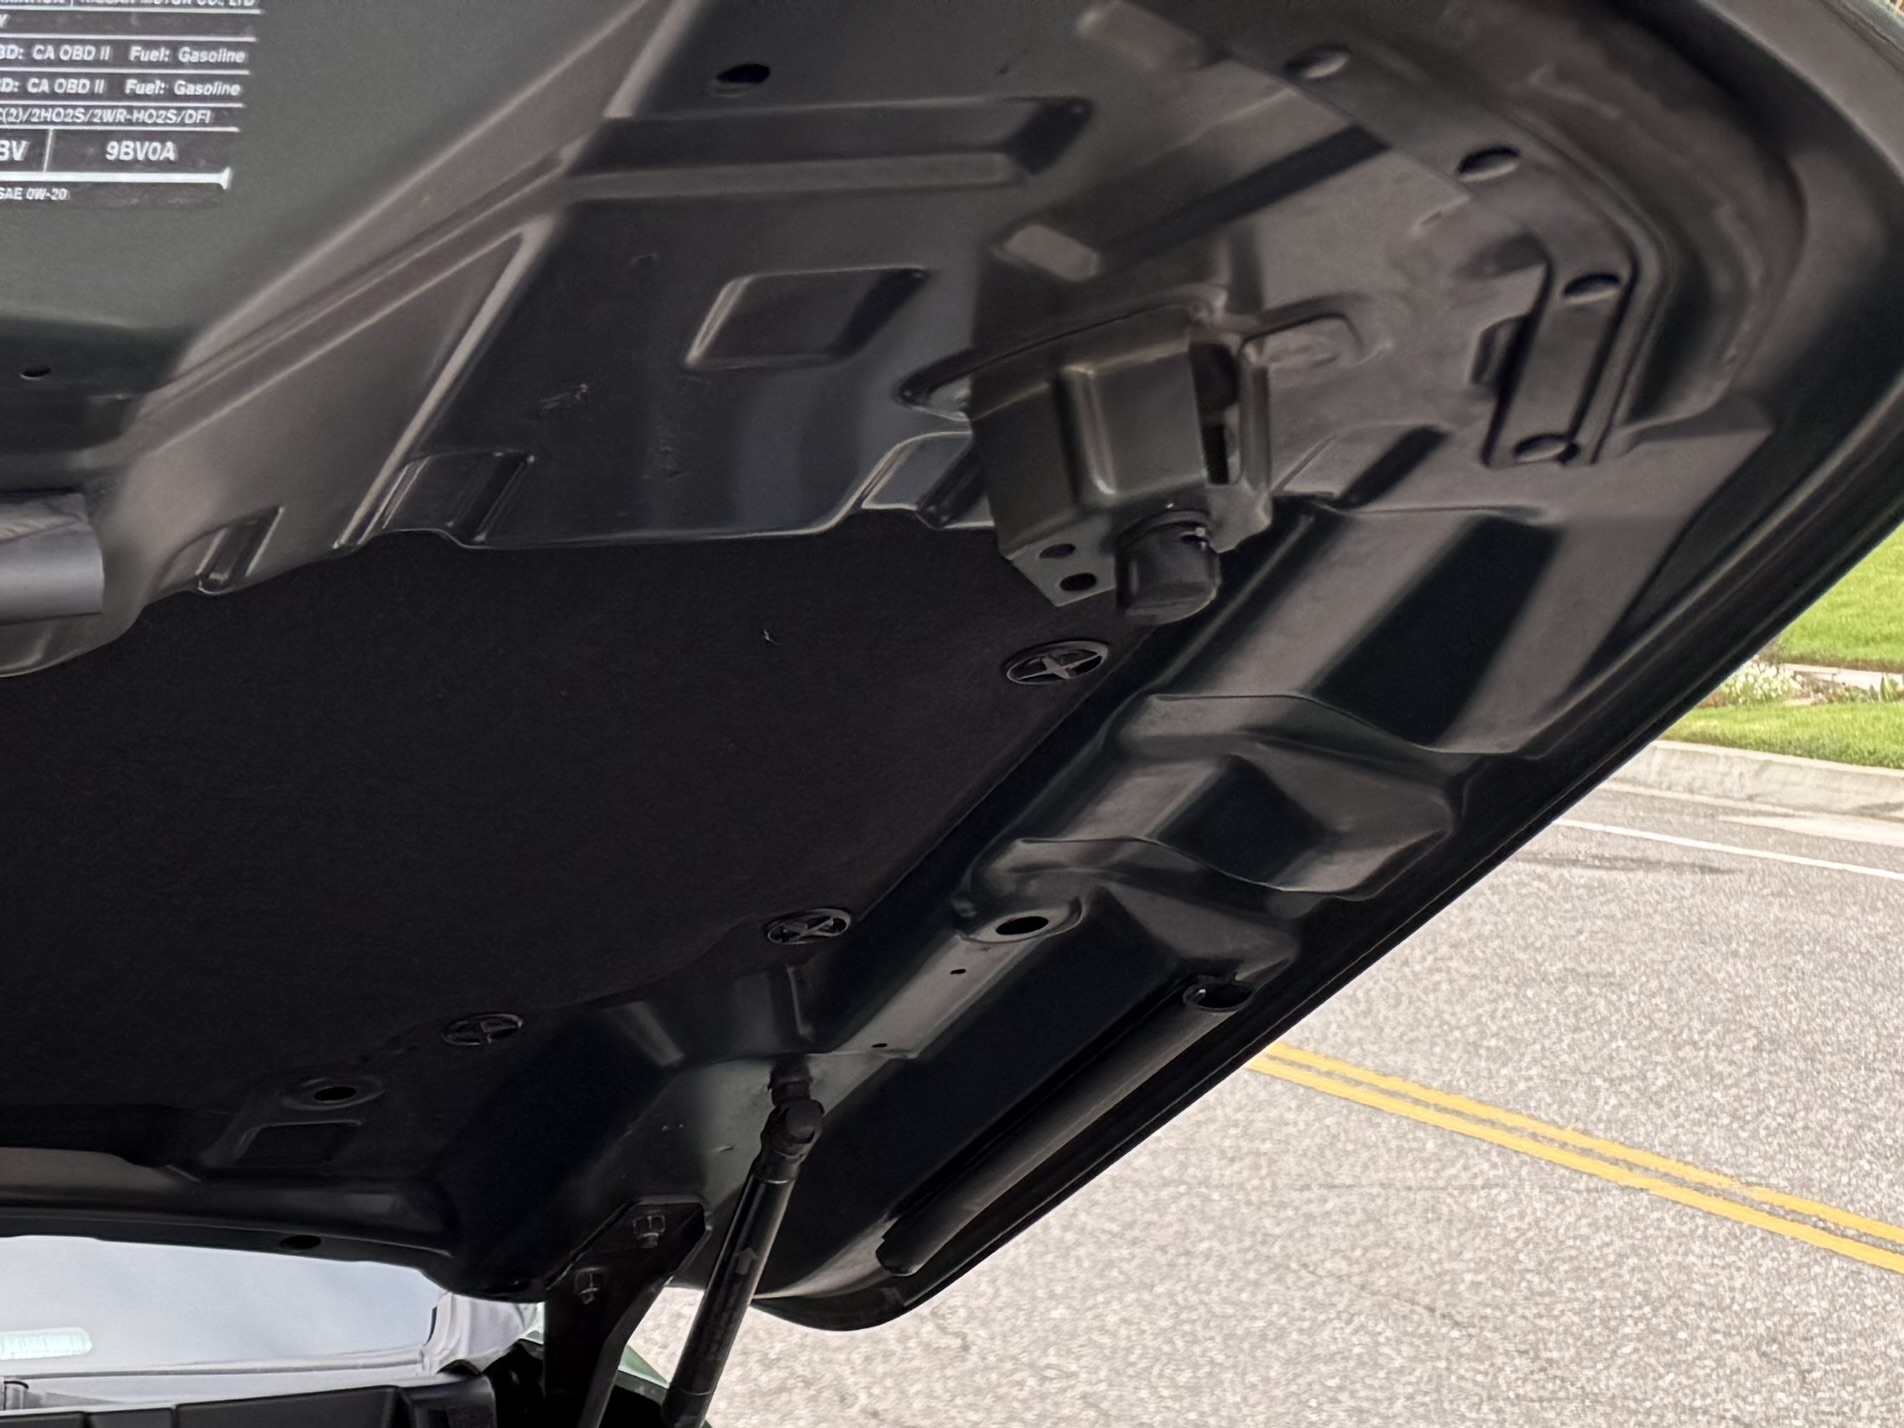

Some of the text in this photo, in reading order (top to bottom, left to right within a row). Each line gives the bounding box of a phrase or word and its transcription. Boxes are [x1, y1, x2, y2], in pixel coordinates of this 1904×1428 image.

[32, 45, 55, 60] CA
[59, 45, 96, 60] OBD
[129, 46, 246, 63] Fuel: Gasoline
[27, 78, 49, 93] CA
[54, 78, 90, 94] OBD
[125, 79, 241, 96] Fuel: Gasoline
[26, 187, 67, 200] 0W-20
